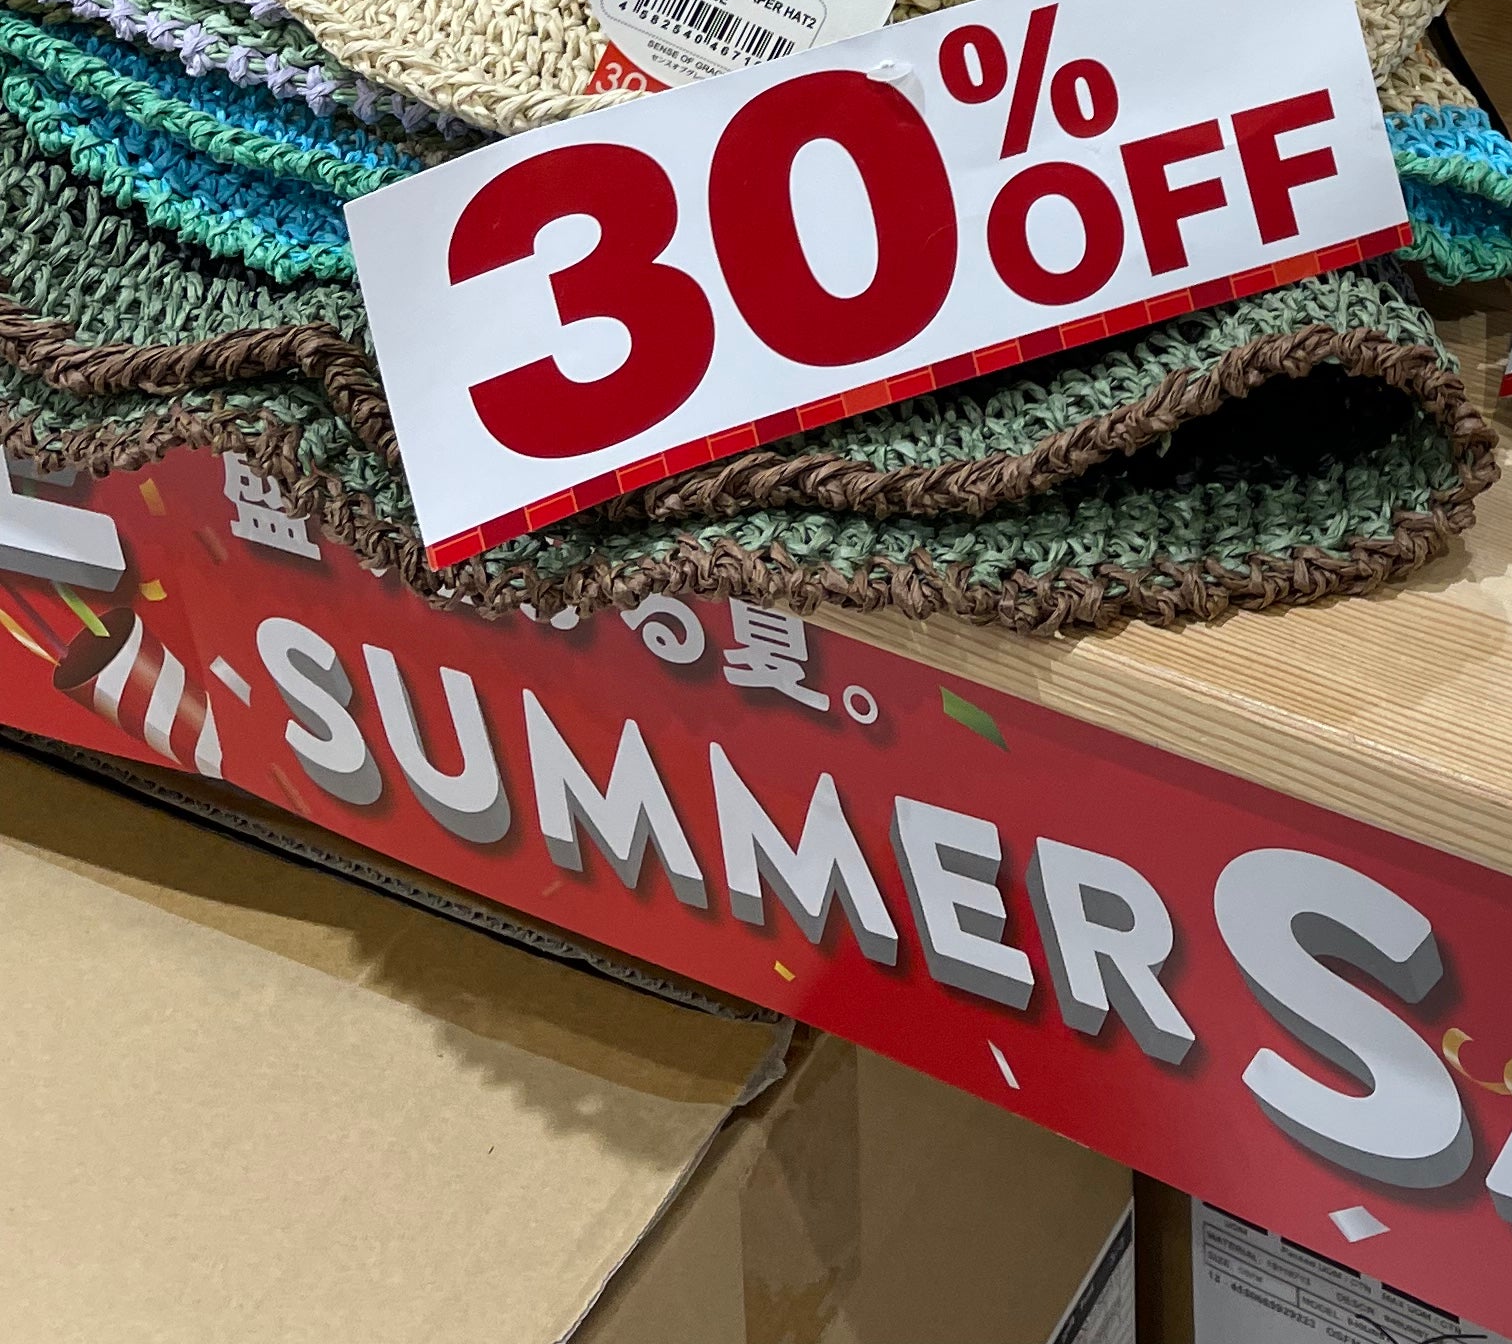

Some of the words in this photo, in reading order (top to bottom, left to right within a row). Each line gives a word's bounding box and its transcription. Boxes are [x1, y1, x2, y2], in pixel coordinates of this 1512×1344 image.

[784, 5, 818, 30] HAT2
[647, 39, 680, 58] SENSE
[680, 53, 695, 66] OF
[694, 59, 731, 77] GRAC
[709, 41, 763, 66] 4671
[986, 88, 1338, 306] OFF
[255, 615, 1196, 1066] SUMMER
